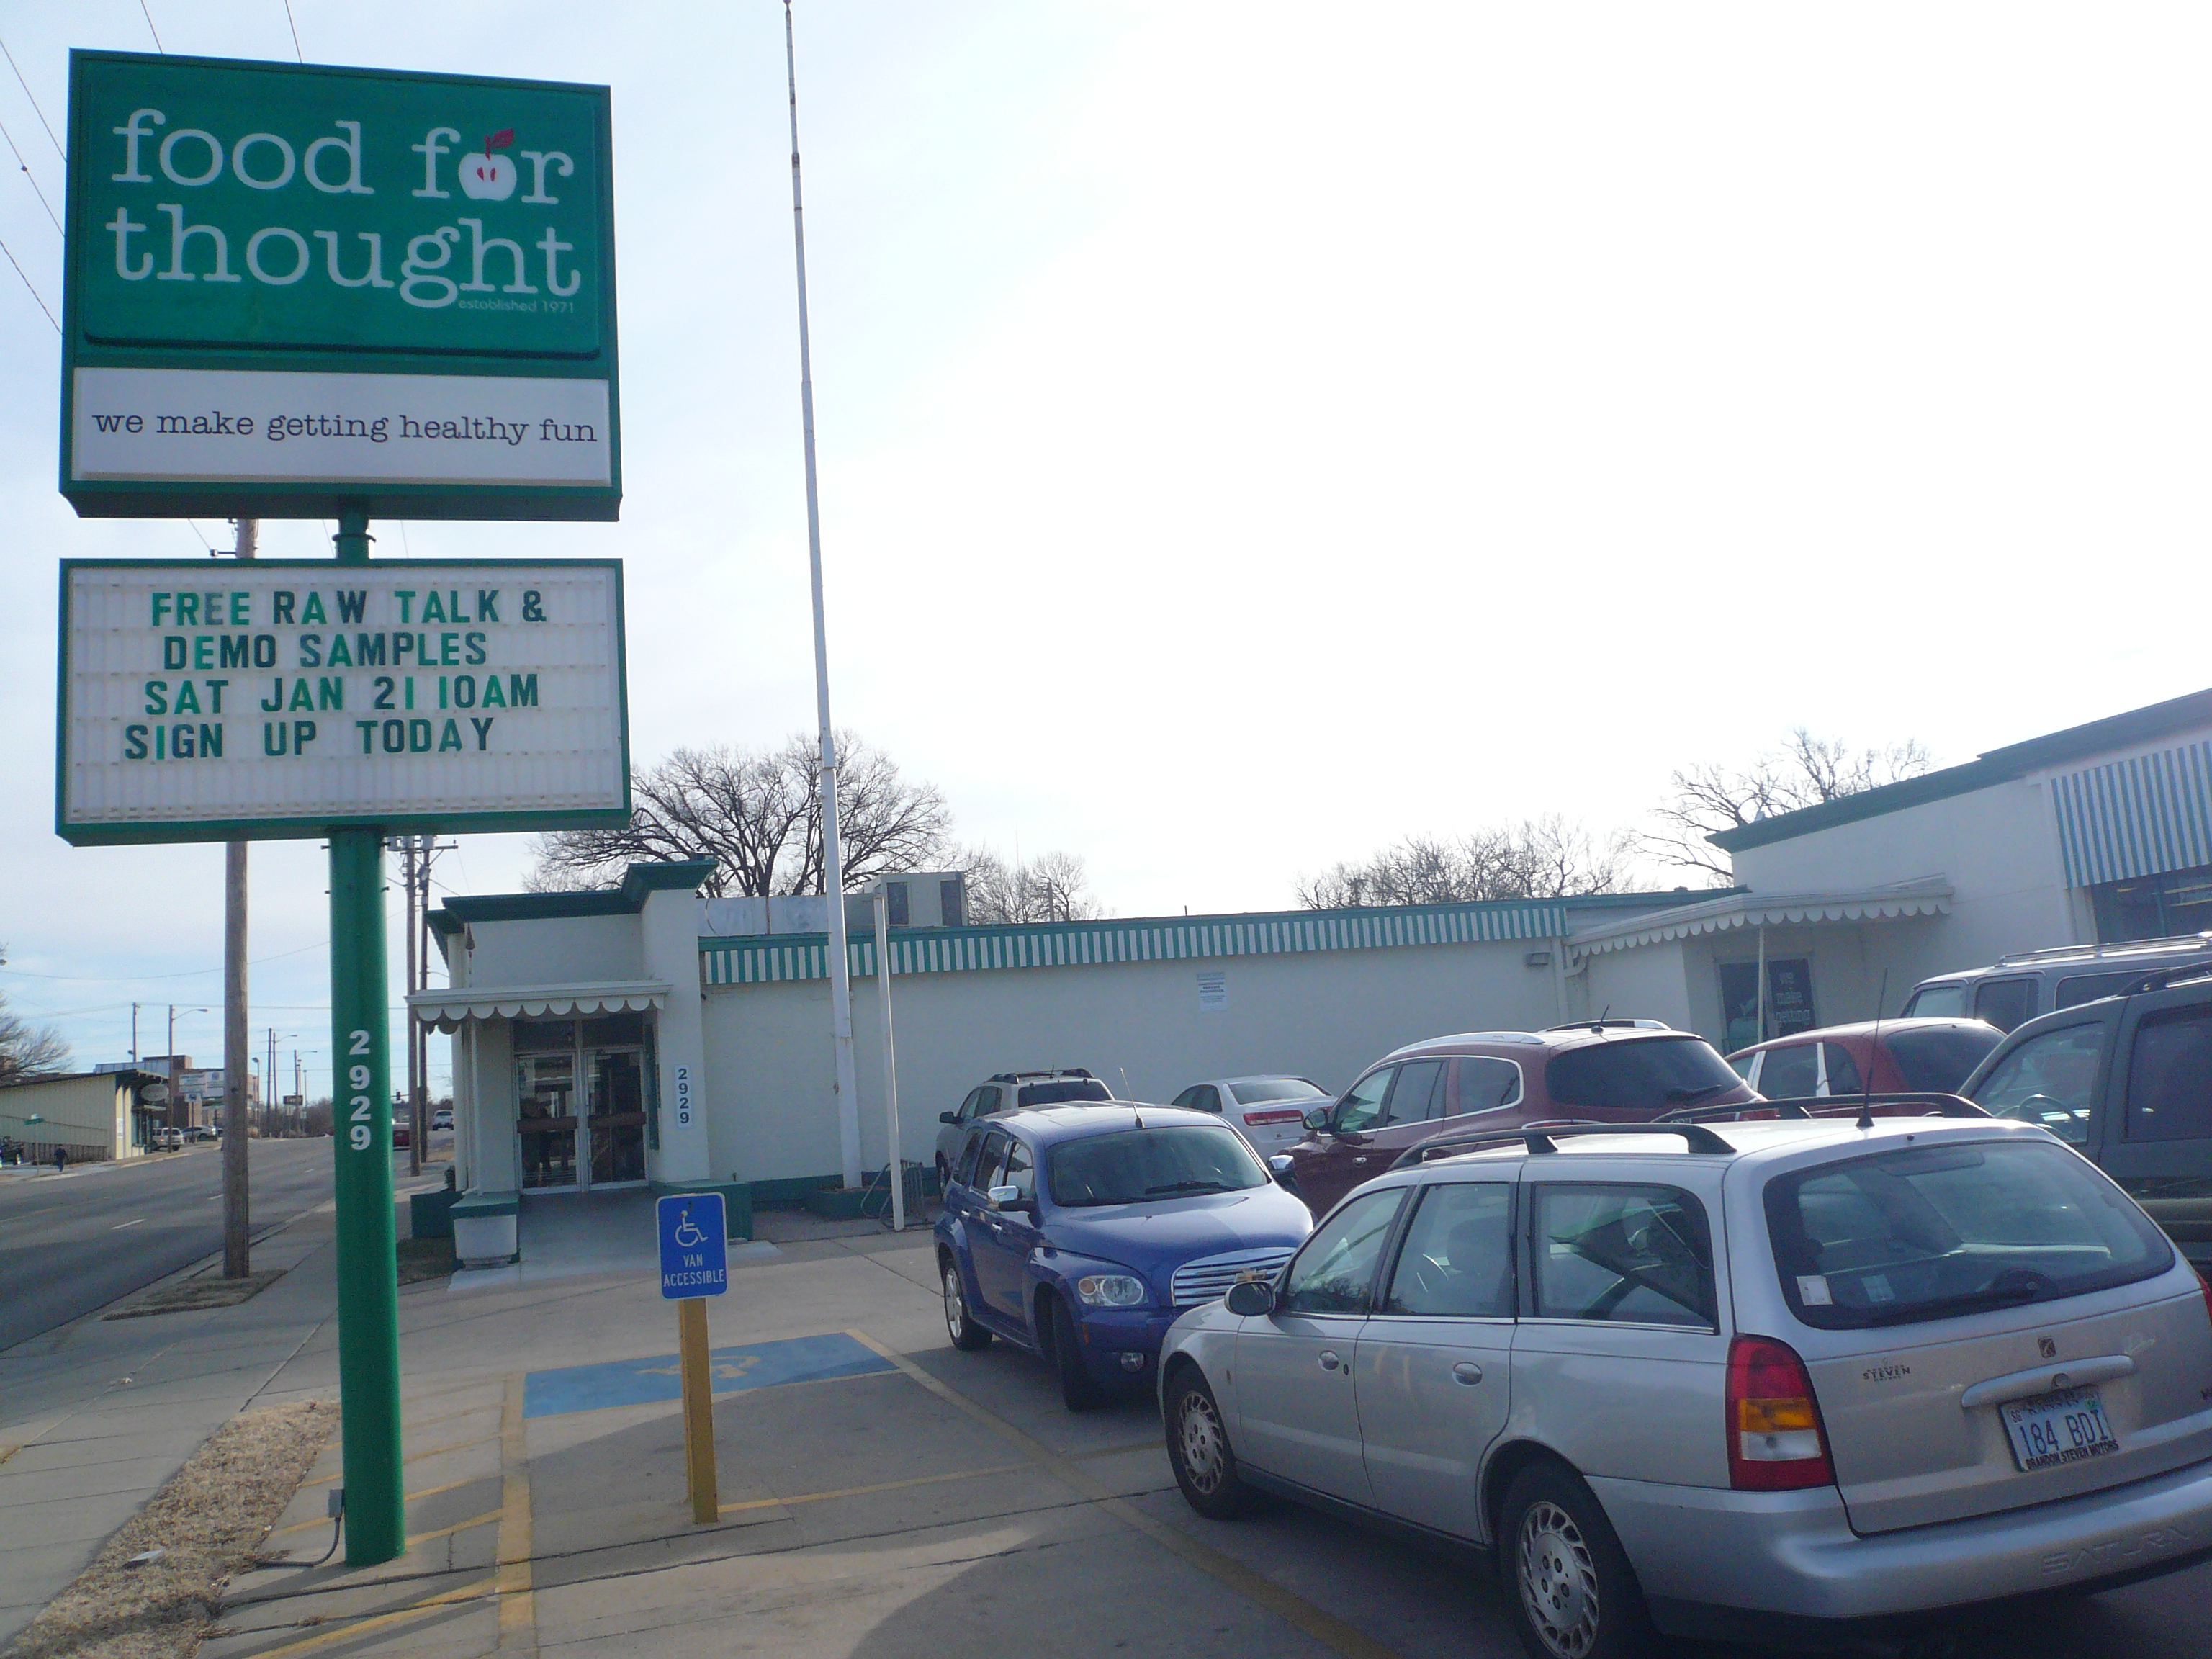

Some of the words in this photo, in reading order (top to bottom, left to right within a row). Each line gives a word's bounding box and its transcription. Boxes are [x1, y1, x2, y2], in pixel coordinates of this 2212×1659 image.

[111, 108, 374, 195] food
[411, 127, 574, 204] for
[105, 203, 581, 308] thought
[458, 298, 537, 312] established
[543, 300, 574, 313] 1971
[92, 414, 143, 434] we
[156, 411, 254, 435] make
[267, 413, 389, 443] getting
[400, 415, 529, 446] healthy
[539, 419, 598, 443] fun
[151, 591, 251, 627] FREE
[273, 590, 368, 625] RAW
[395, 589, 500, 624] TALK
[522, 590, 547, 623] &
[163, 634, 277, 671] DEMO
[299, 631, 487, 668] SAMPLES
[144, 679, 230, 715] SAT
[261, 675, 344, 713] JAN
[373, 675, 415, 711] 21
[124, 723, 223, 760] SIGN
[264, 720, 318, 757] UP
[356, 717, 495, 754] TODAY
[349, 1030, 372, 1151] 2929
[678, 1068, 690, 1124] 2929
[663, 1269, 725, 1287] ACCESSIBLE
[683, 1253, 703, 1268] VAN
[2020, 1420, 2059, 1457] 184
[2026, 1452, 2062, 1470] BRANDON
[2061, 1446, 2089, 1463] STEVEN
[2089, 1439, 2120, 1457] MOTORS
